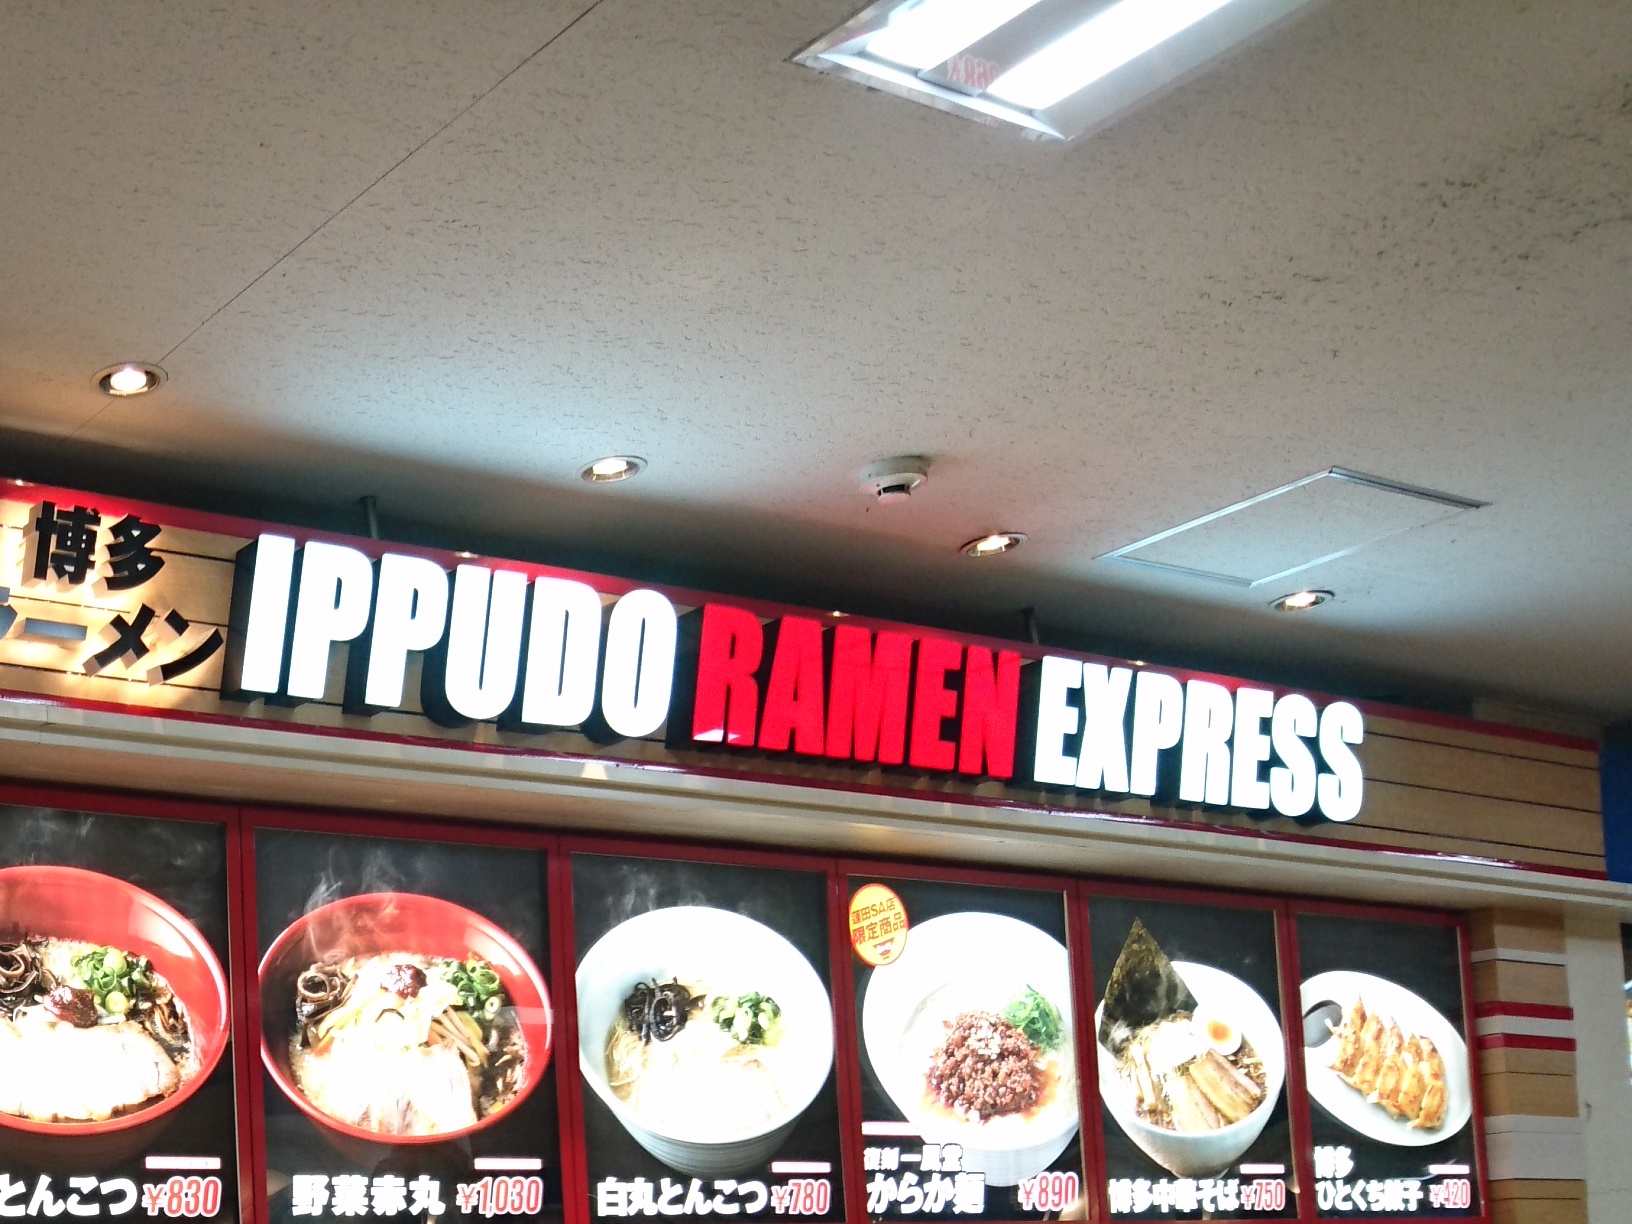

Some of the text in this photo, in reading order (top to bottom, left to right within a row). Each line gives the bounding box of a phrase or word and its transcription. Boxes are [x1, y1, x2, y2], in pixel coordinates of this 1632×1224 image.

[25, 500, 166, 590] 博多
[240, 532, 1365, 823] IPPUDO RAMEN EXPRESS
[852, 911, 907, 945] 限定商品
[141, 1175, 223, 1218] ¥830
[291, 1174, 544, 1219] 野菜赤丸 ¥1,030
[596, 1176, 831, 1217] 白丸とんこつ ¥780
[1018, 1171, 1079, 1212] ¥890
[1240, 1178, 1286, 1211] ¥750
[1429, 1179, 1471, 1209] ¥420
